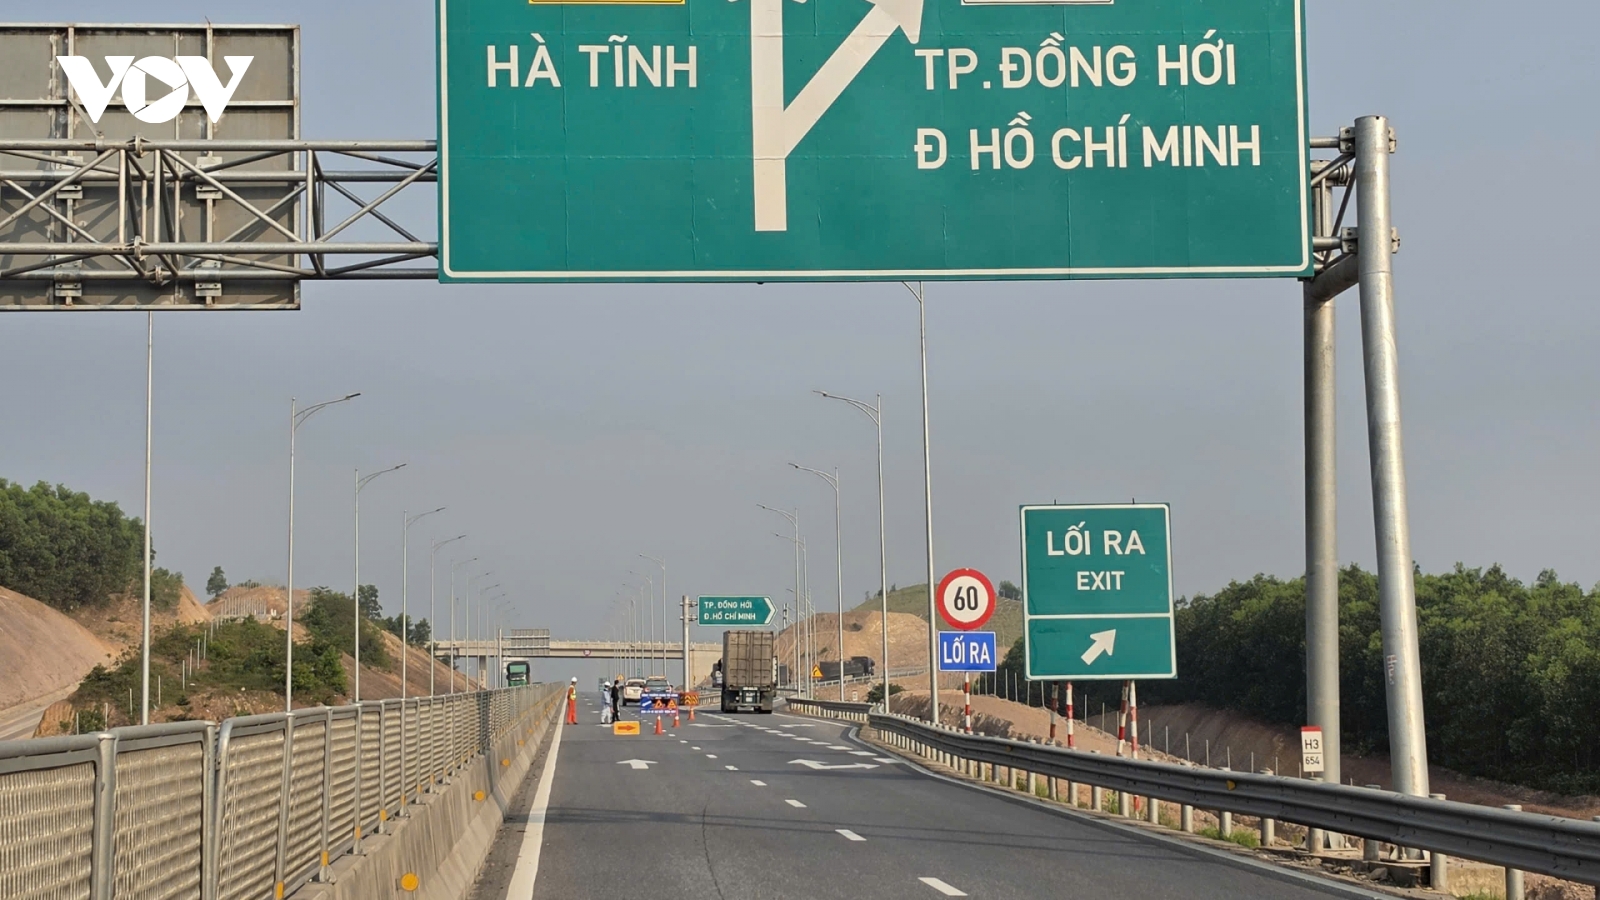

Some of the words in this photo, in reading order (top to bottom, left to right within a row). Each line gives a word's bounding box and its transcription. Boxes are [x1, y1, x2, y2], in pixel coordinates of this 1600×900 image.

[488, 32, 561, 88] HÀ
[579, 34, 697, 88] TĨNH
[1158, 29, 1236, 87] HỚI
[914, 127, 948, 170] Đ
[970, 111, 1035, 170] HỒ
[1052, 113, 1128, 168] CHÍ
[1143, 124, 1261, 167] MINH
[1047, 521, 1092, 556] LỐI
[1104, 530, 1146, 555] RA
[1077, 570, 1125, 591] EXIT
[953, 586, 979, 611] 60
[724, 611, 737, 620] CHÍ
[943, 635, 965, 664] LỐI
[970, 641, 991, 664] RA
[1304, 738, 1319, 750] H3
[1305, 756, 1320, 765] 654
